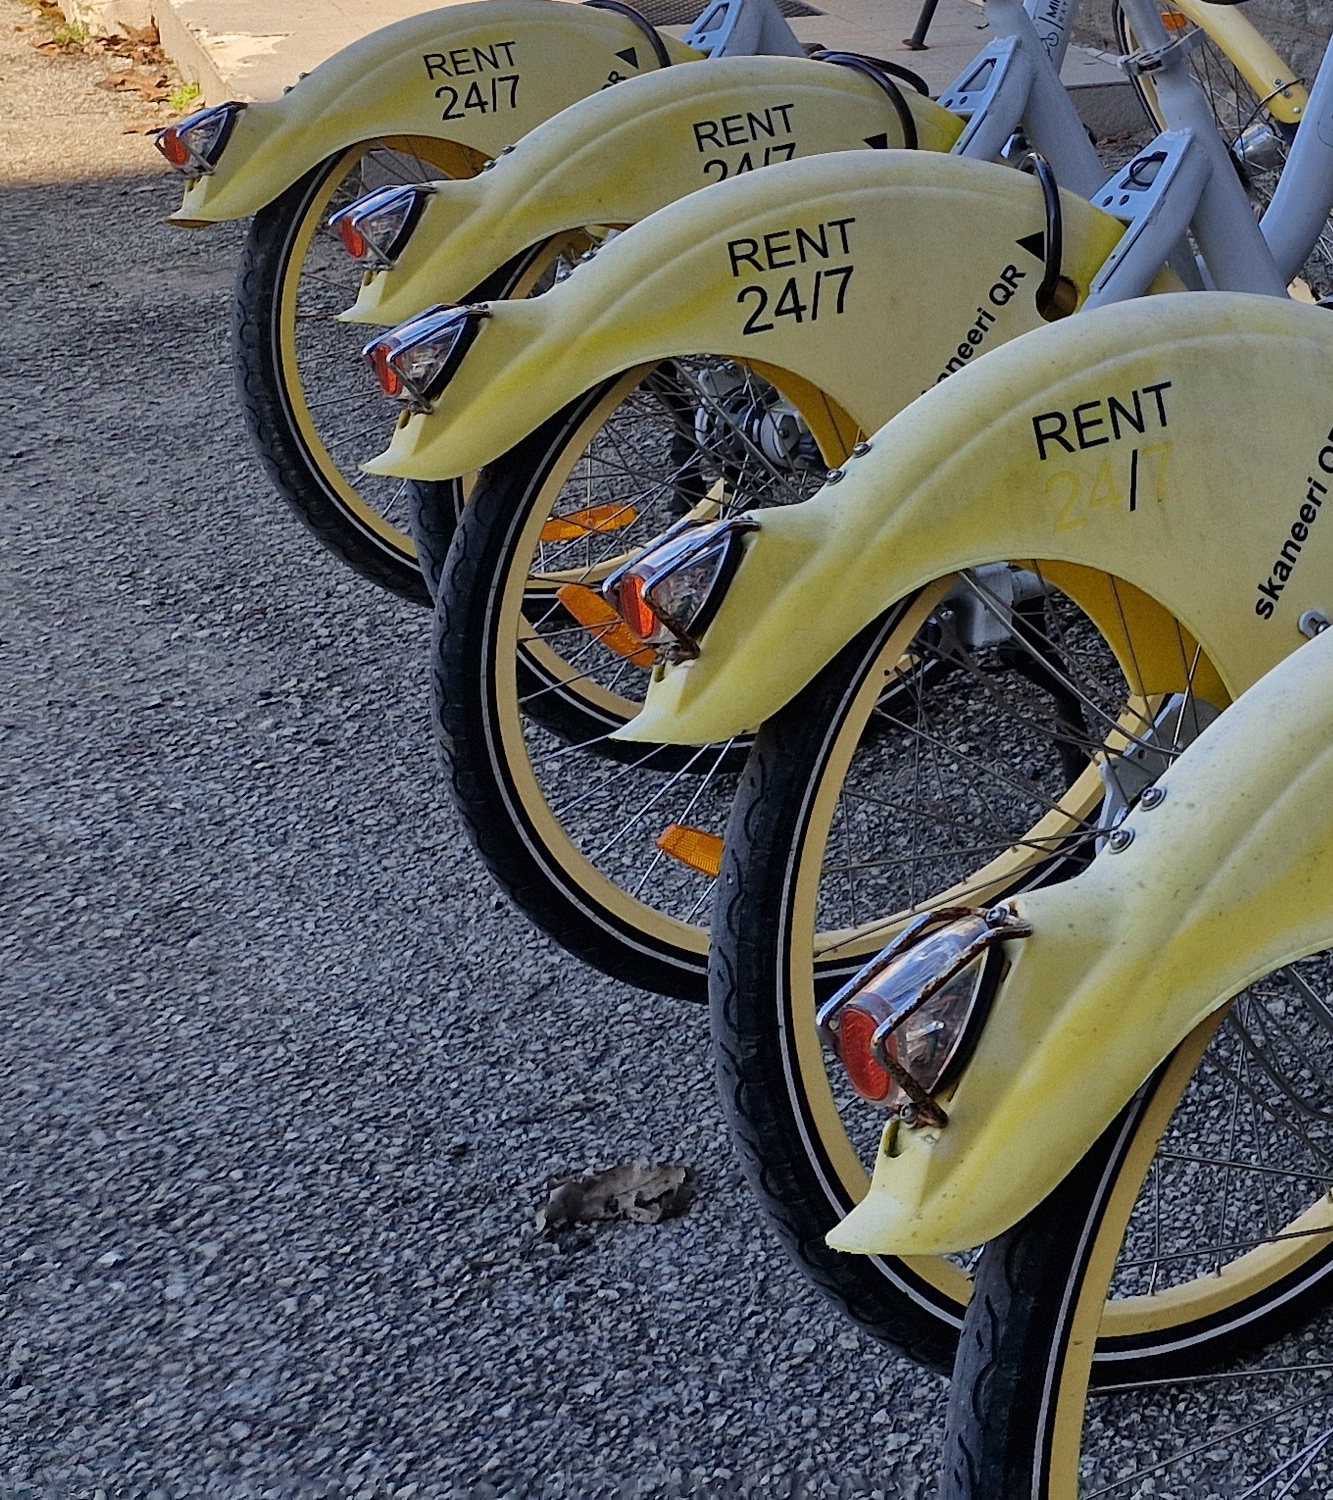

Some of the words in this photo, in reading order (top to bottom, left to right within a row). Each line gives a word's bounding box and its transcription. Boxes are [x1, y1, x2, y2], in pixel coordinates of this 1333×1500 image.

[423, 41, 516, 80] RENT
[435, 75, 520, 121] 24/7
[693, 103, 795, 152] RENT
[727, 217, 856, 277] RENT
[737, 265, 854, 336] 24/7
[988, 264, 1027, 306] QR
[1032, 381, 1172, 461] RENT
[1255, 476, 1329, 621] skaneeri
